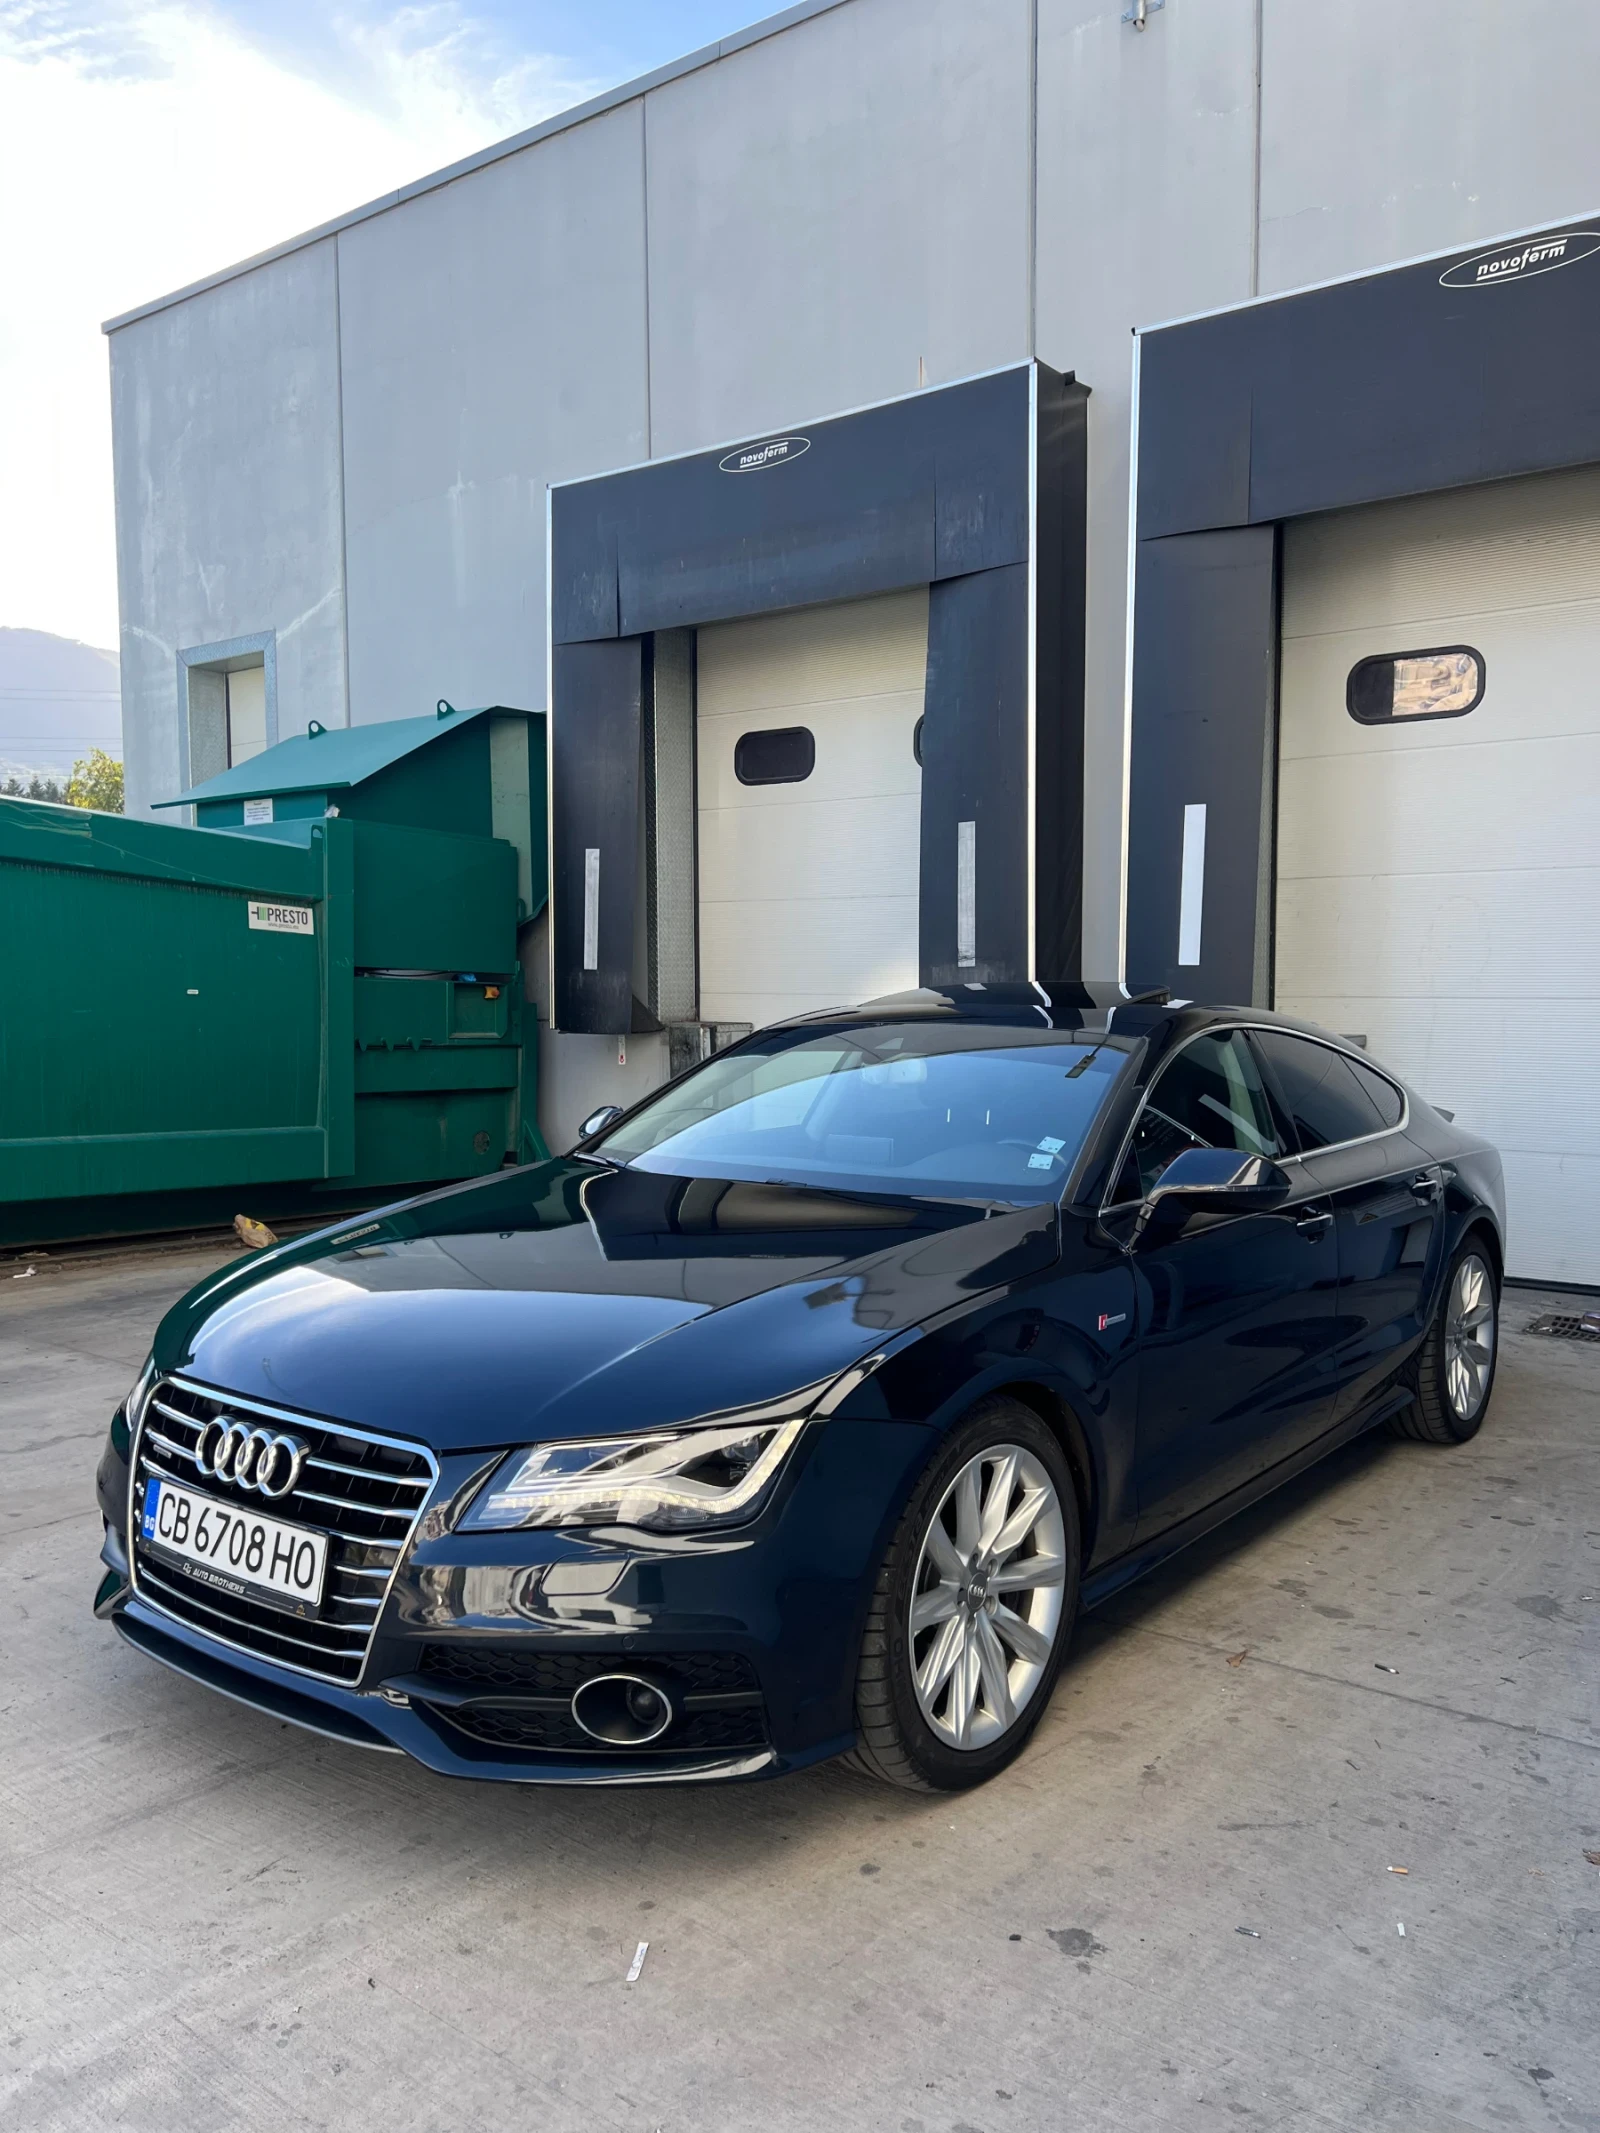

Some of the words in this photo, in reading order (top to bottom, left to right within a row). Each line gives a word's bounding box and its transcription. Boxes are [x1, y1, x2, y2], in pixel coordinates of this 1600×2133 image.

[1476, 242, 1567, 277] novoferm
[740, 443, 788, 466] novoferm
[267, 907, 308, 925] PRESTO
[144, 1515, 155, 1531] BG
[159, 1493, 191, 1544] CB
[194, 1507, 265, 1573] 6708
[269, 1531, 316, 1589] HO
[193, 1568, 209, 1580] AUTO
[208, 1574, 245, 1594] BROTHERS
